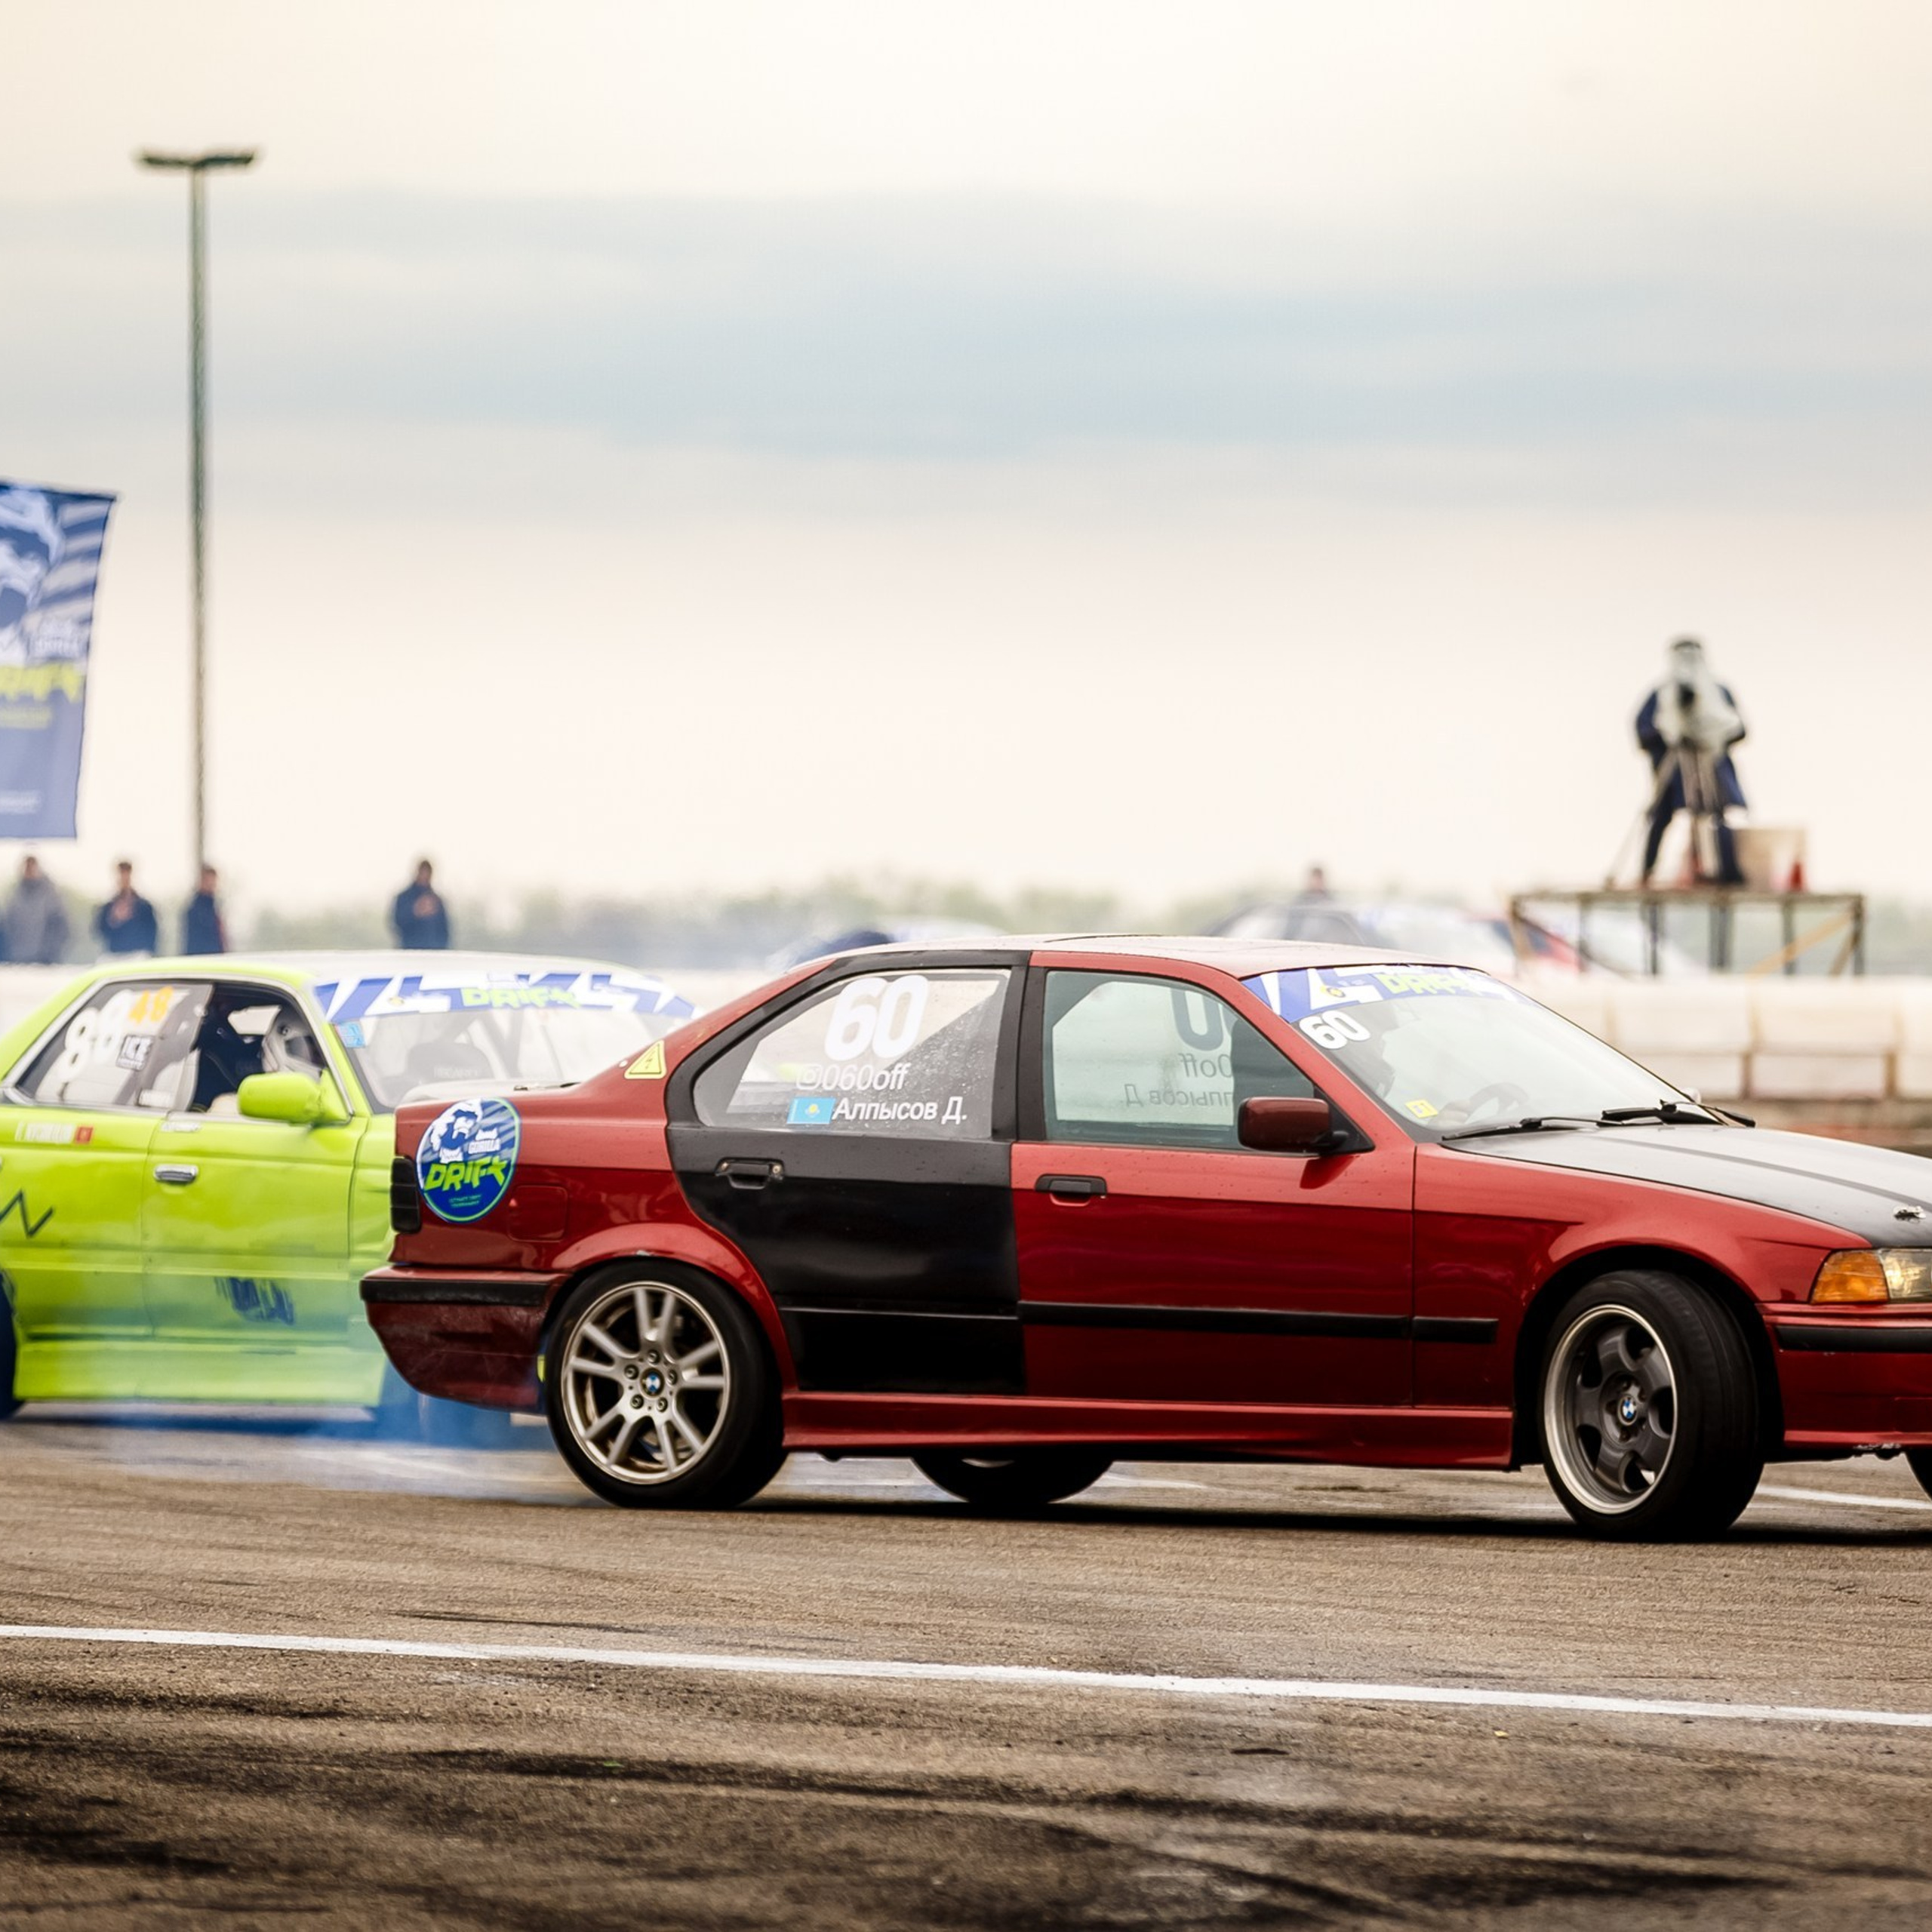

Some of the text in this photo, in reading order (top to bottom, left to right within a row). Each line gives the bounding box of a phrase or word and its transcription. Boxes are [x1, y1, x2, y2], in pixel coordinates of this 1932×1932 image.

[824, 974, 929, 1061] 60
[1300, 1010, 1371, 1049] 60
[941, 1095, 968, 1124] Д.
[423, 1155, 508, 1192] DRIFT
